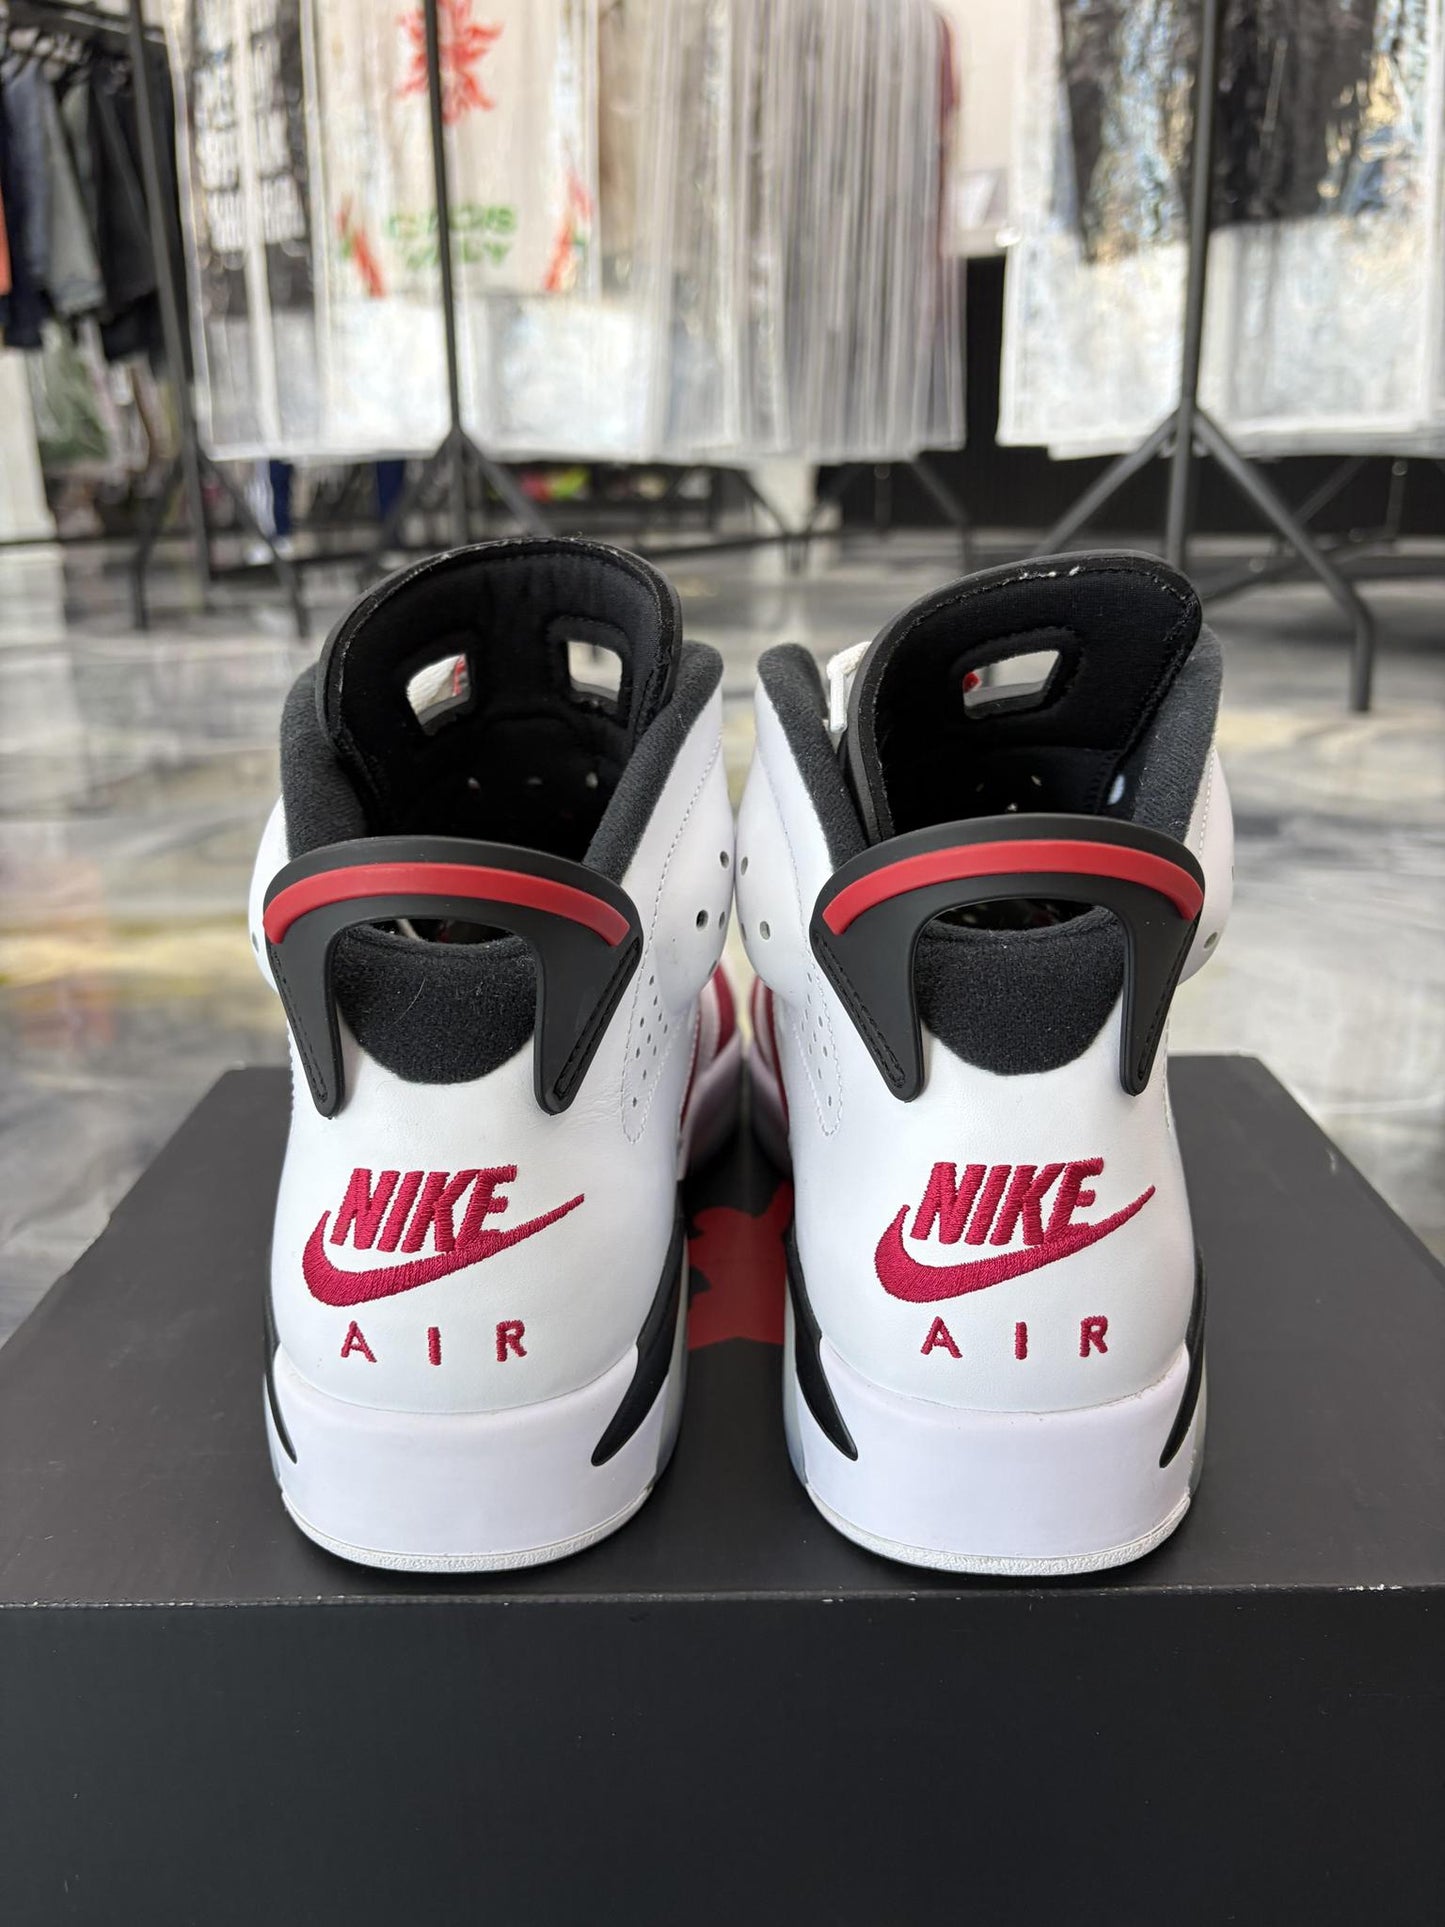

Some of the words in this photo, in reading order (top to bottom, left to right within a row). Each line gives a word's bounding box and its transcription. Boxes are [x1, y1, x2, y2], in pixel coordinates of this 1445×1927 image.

[329, 1164, 518, 1253] NIKE
[910, 1157, 1104, 1248] NIKE
[340, 1320, 528, 1366] AIR
[919, 1315, 1109, 1361] AIR
